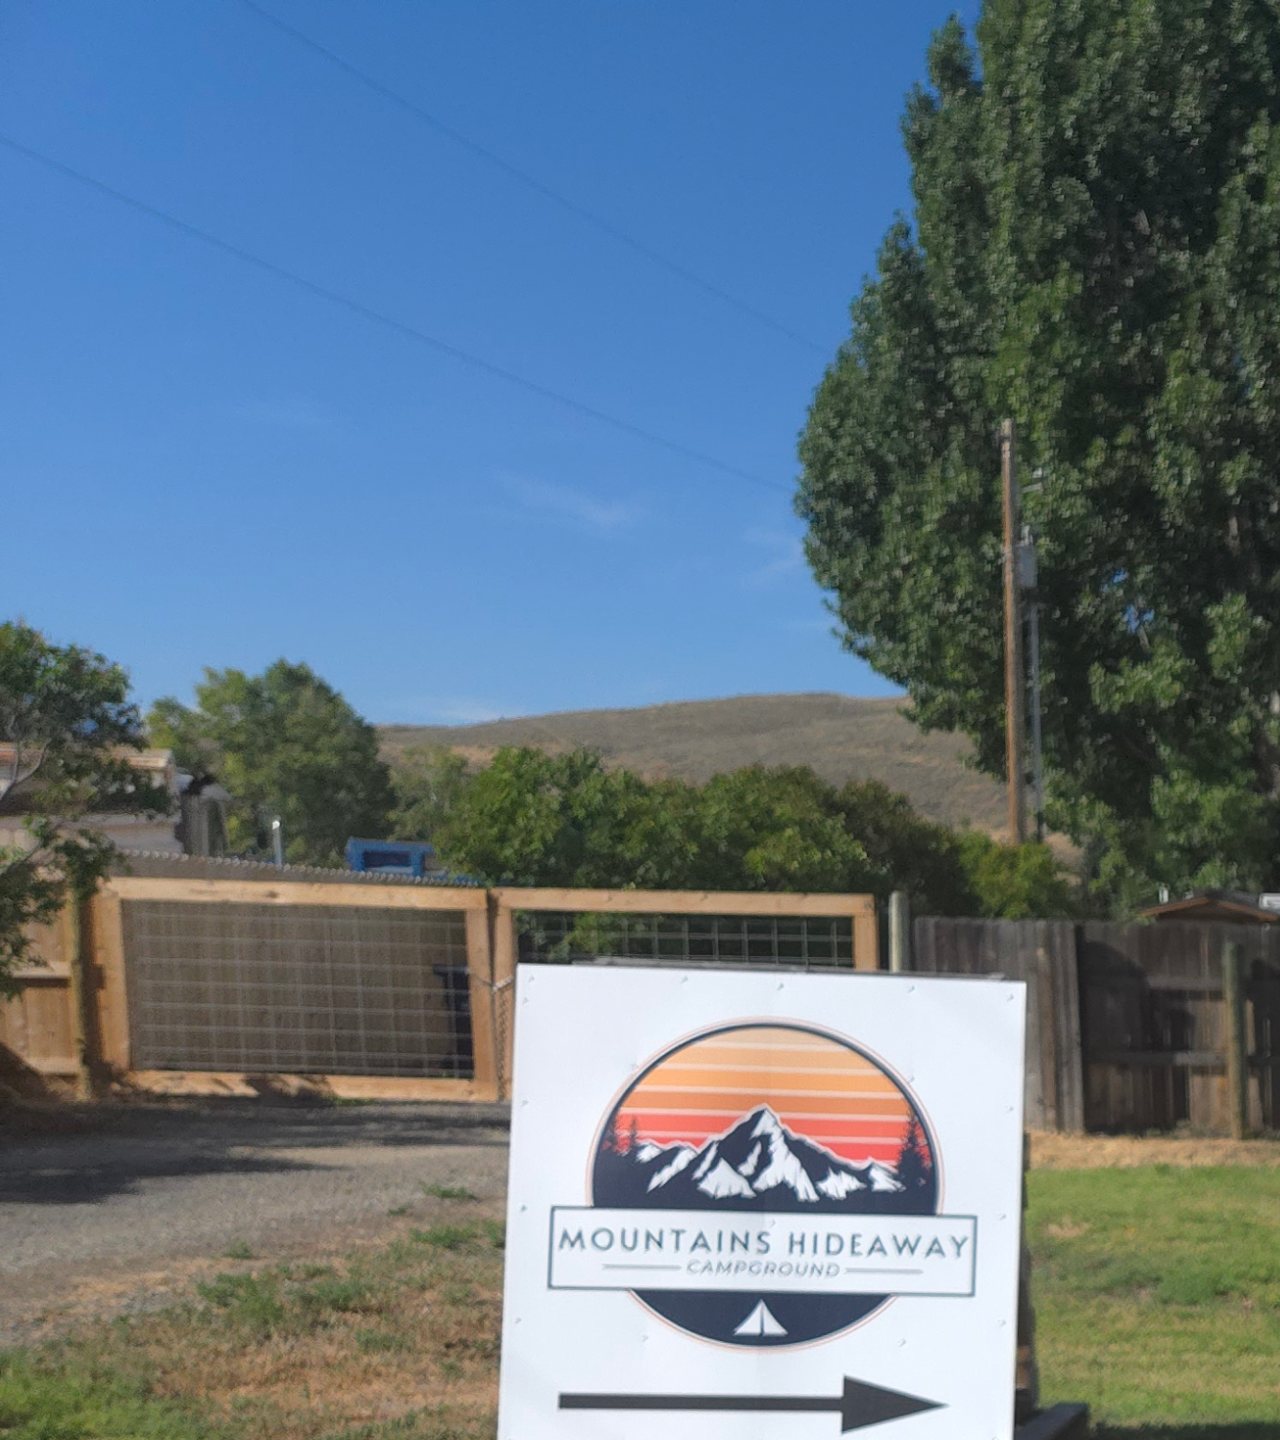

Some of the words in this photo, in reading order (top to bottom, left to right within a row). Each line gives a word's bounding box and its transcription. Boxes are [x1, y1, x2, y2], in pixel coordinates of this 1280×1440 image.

[558, 1228, 772, 1255] MOUNTAINS
[787, 1232, 970, 1258] HIDEAWAY
[686, 1259, 841, 1278] CAMPGROUND
